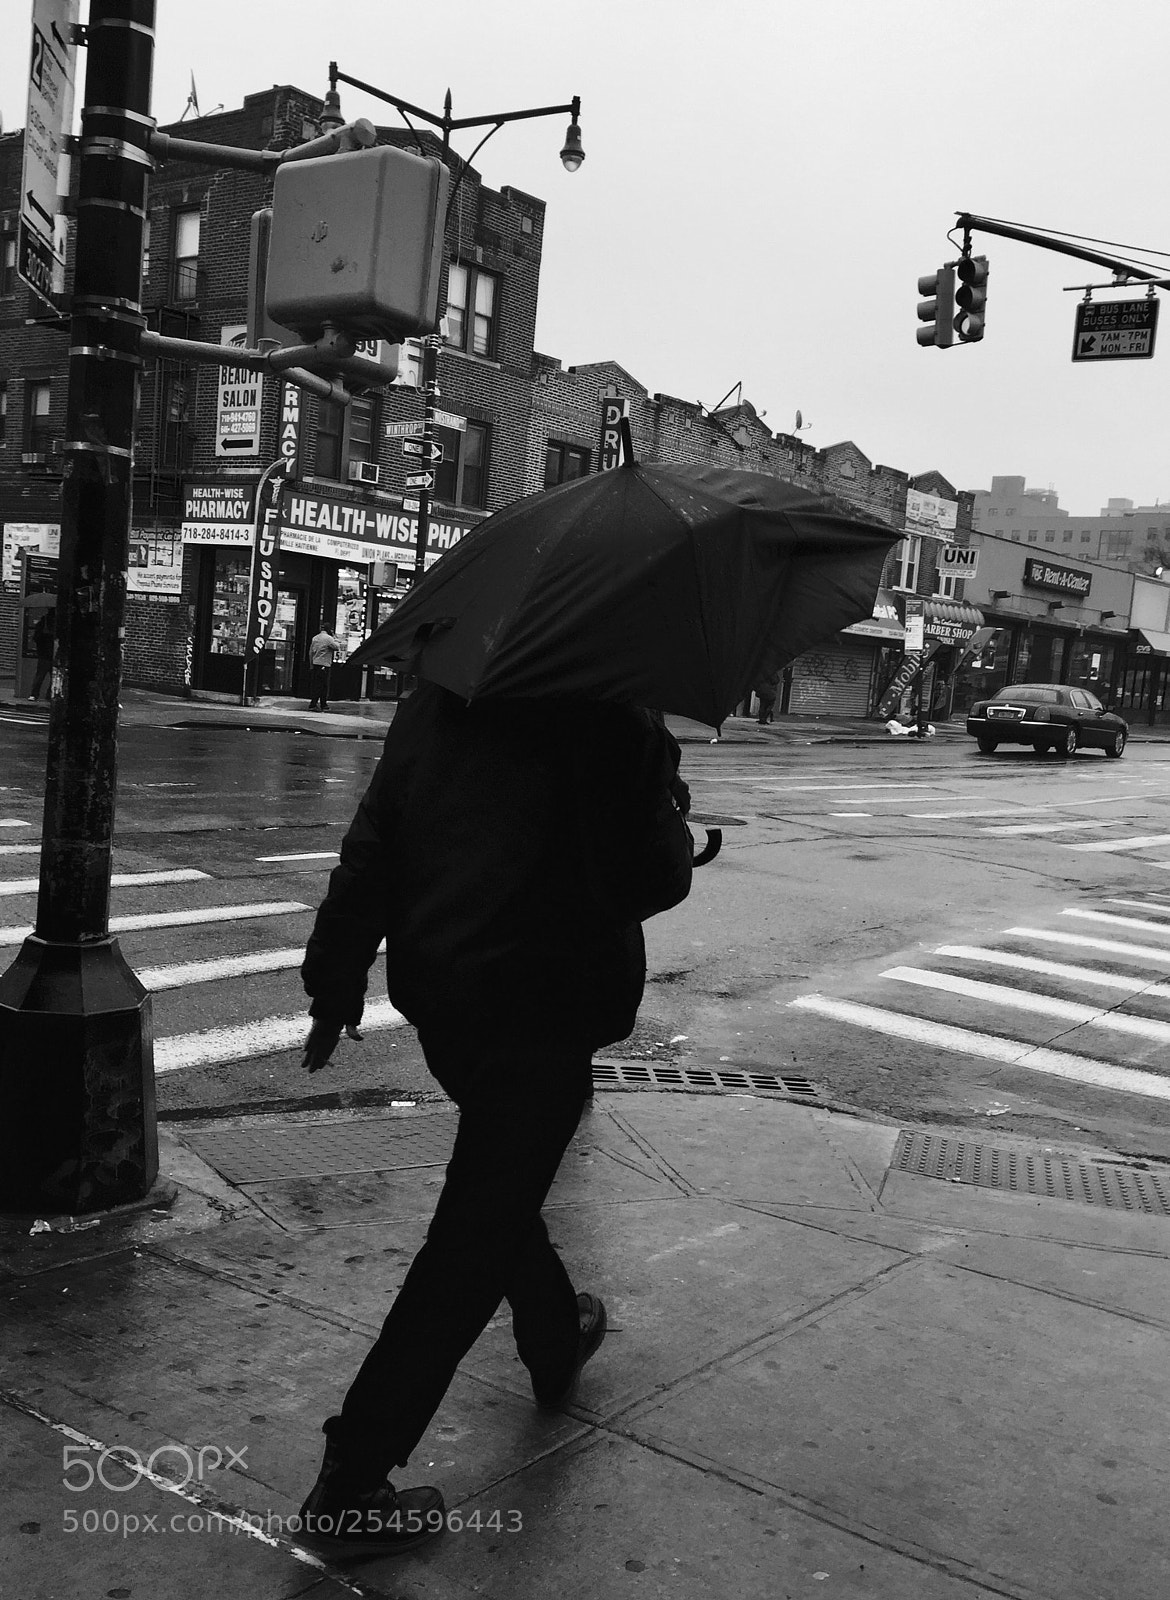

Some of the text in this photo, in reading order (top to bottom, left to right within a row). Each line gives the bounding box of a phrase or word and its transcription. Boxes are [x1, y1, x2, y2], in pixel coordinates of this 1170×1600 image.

[1100, 303, 1149, 314] BUS LANE
[1083, 314, 1150, 326] BUSES ONLY
[1100, 333, 1120, 342] 7AM
[1128, 331, 1148, 340] 7PM
[1100, 344, 1121, 353] MON
[1129, 343, 1145, 352] FRI
[222, 389, 257, 407] SALON
[386, 423, 418, 435] WINTHROP
[408, 443, 420, 453] ONE
[193, 488, 244, 499] HEALTH-WISE
[185, 500, 250, 519] PHARMACY
[290, 498, 419, 544] HEALTH-WISE
[183, 527, 249, 541] 718-284-8414-3
[259, 508, 279, 556] FLU
[944, 548, 977, 565] UNI
[253, 561, 273, 654] SHOTS
[924, 624, 950, 637] ARBER
[951, 628, 974, 641] SHOP
